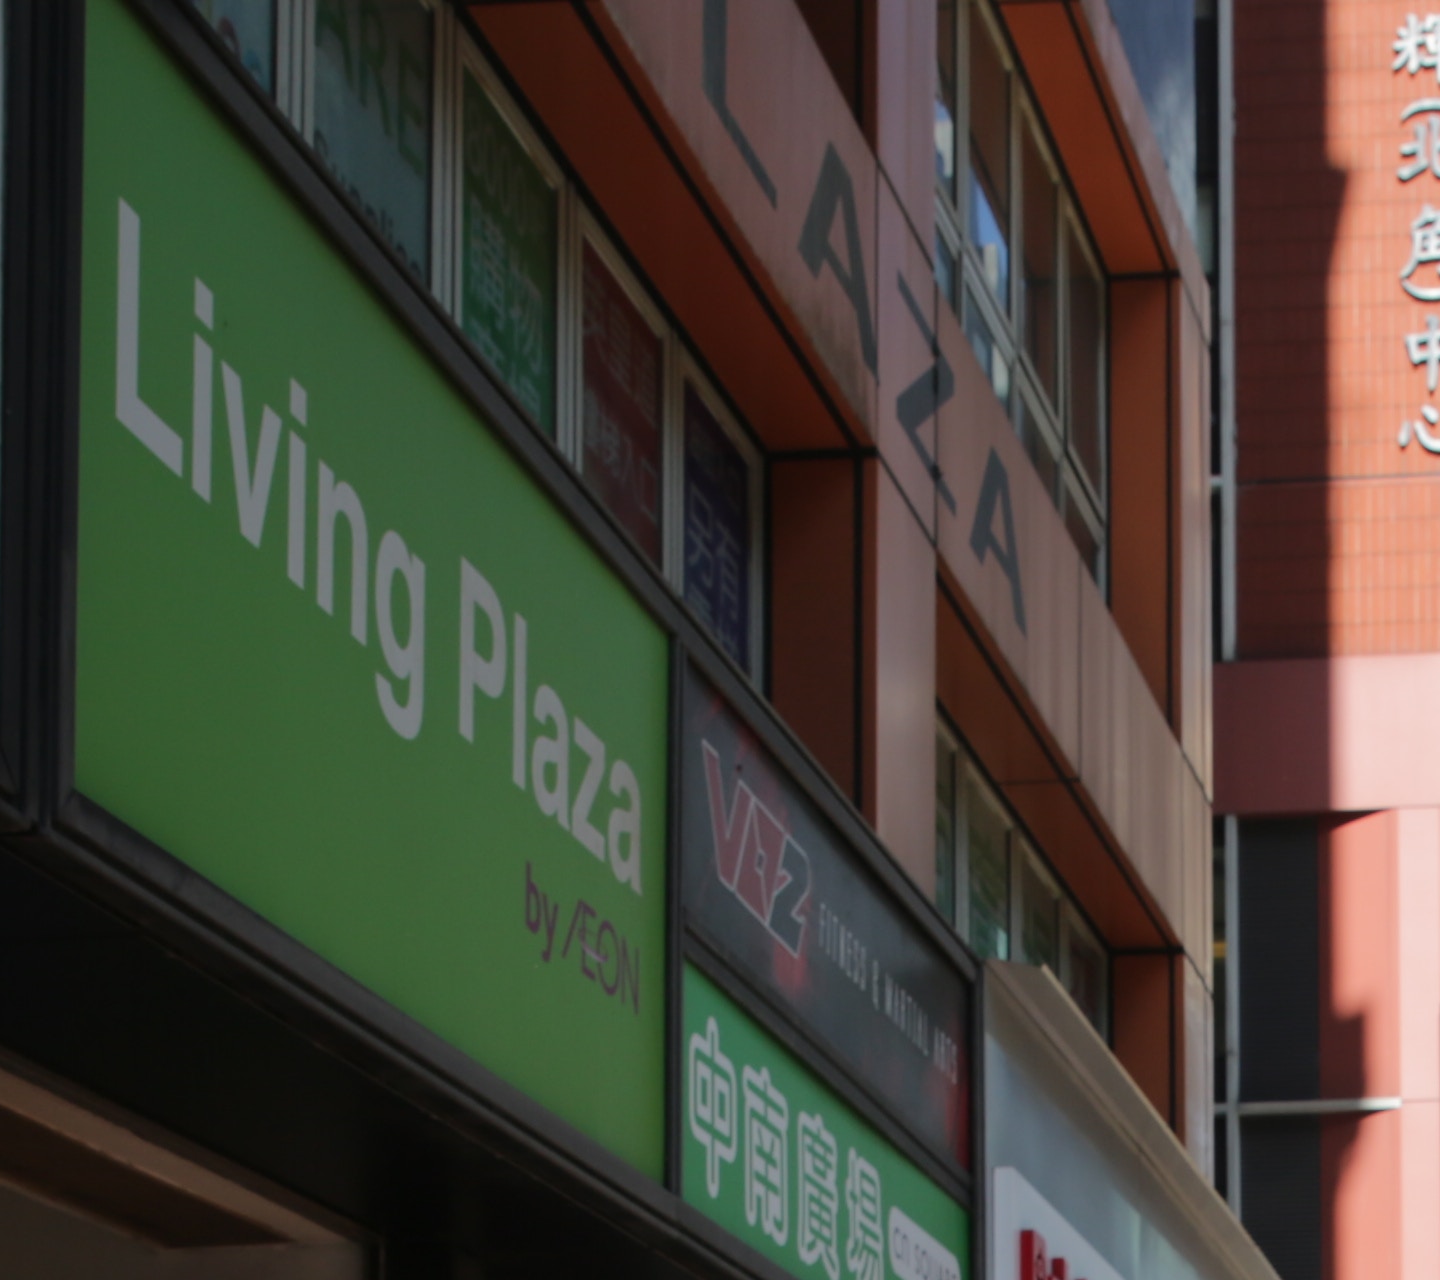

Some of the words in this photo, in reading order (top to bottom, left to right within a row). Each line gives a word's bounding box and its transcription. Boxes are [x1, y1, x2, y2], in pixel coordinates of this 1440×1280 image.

[115, 196, 426, 740] Living
[458, 555, 644, 897] Plaza
[525, 858, 558, 962] by
[818, 902, 867, 992] FITNESS
[884, 970, 930, 1058] MARTIAL
[933, 1022, 958, 1085] ARTS
